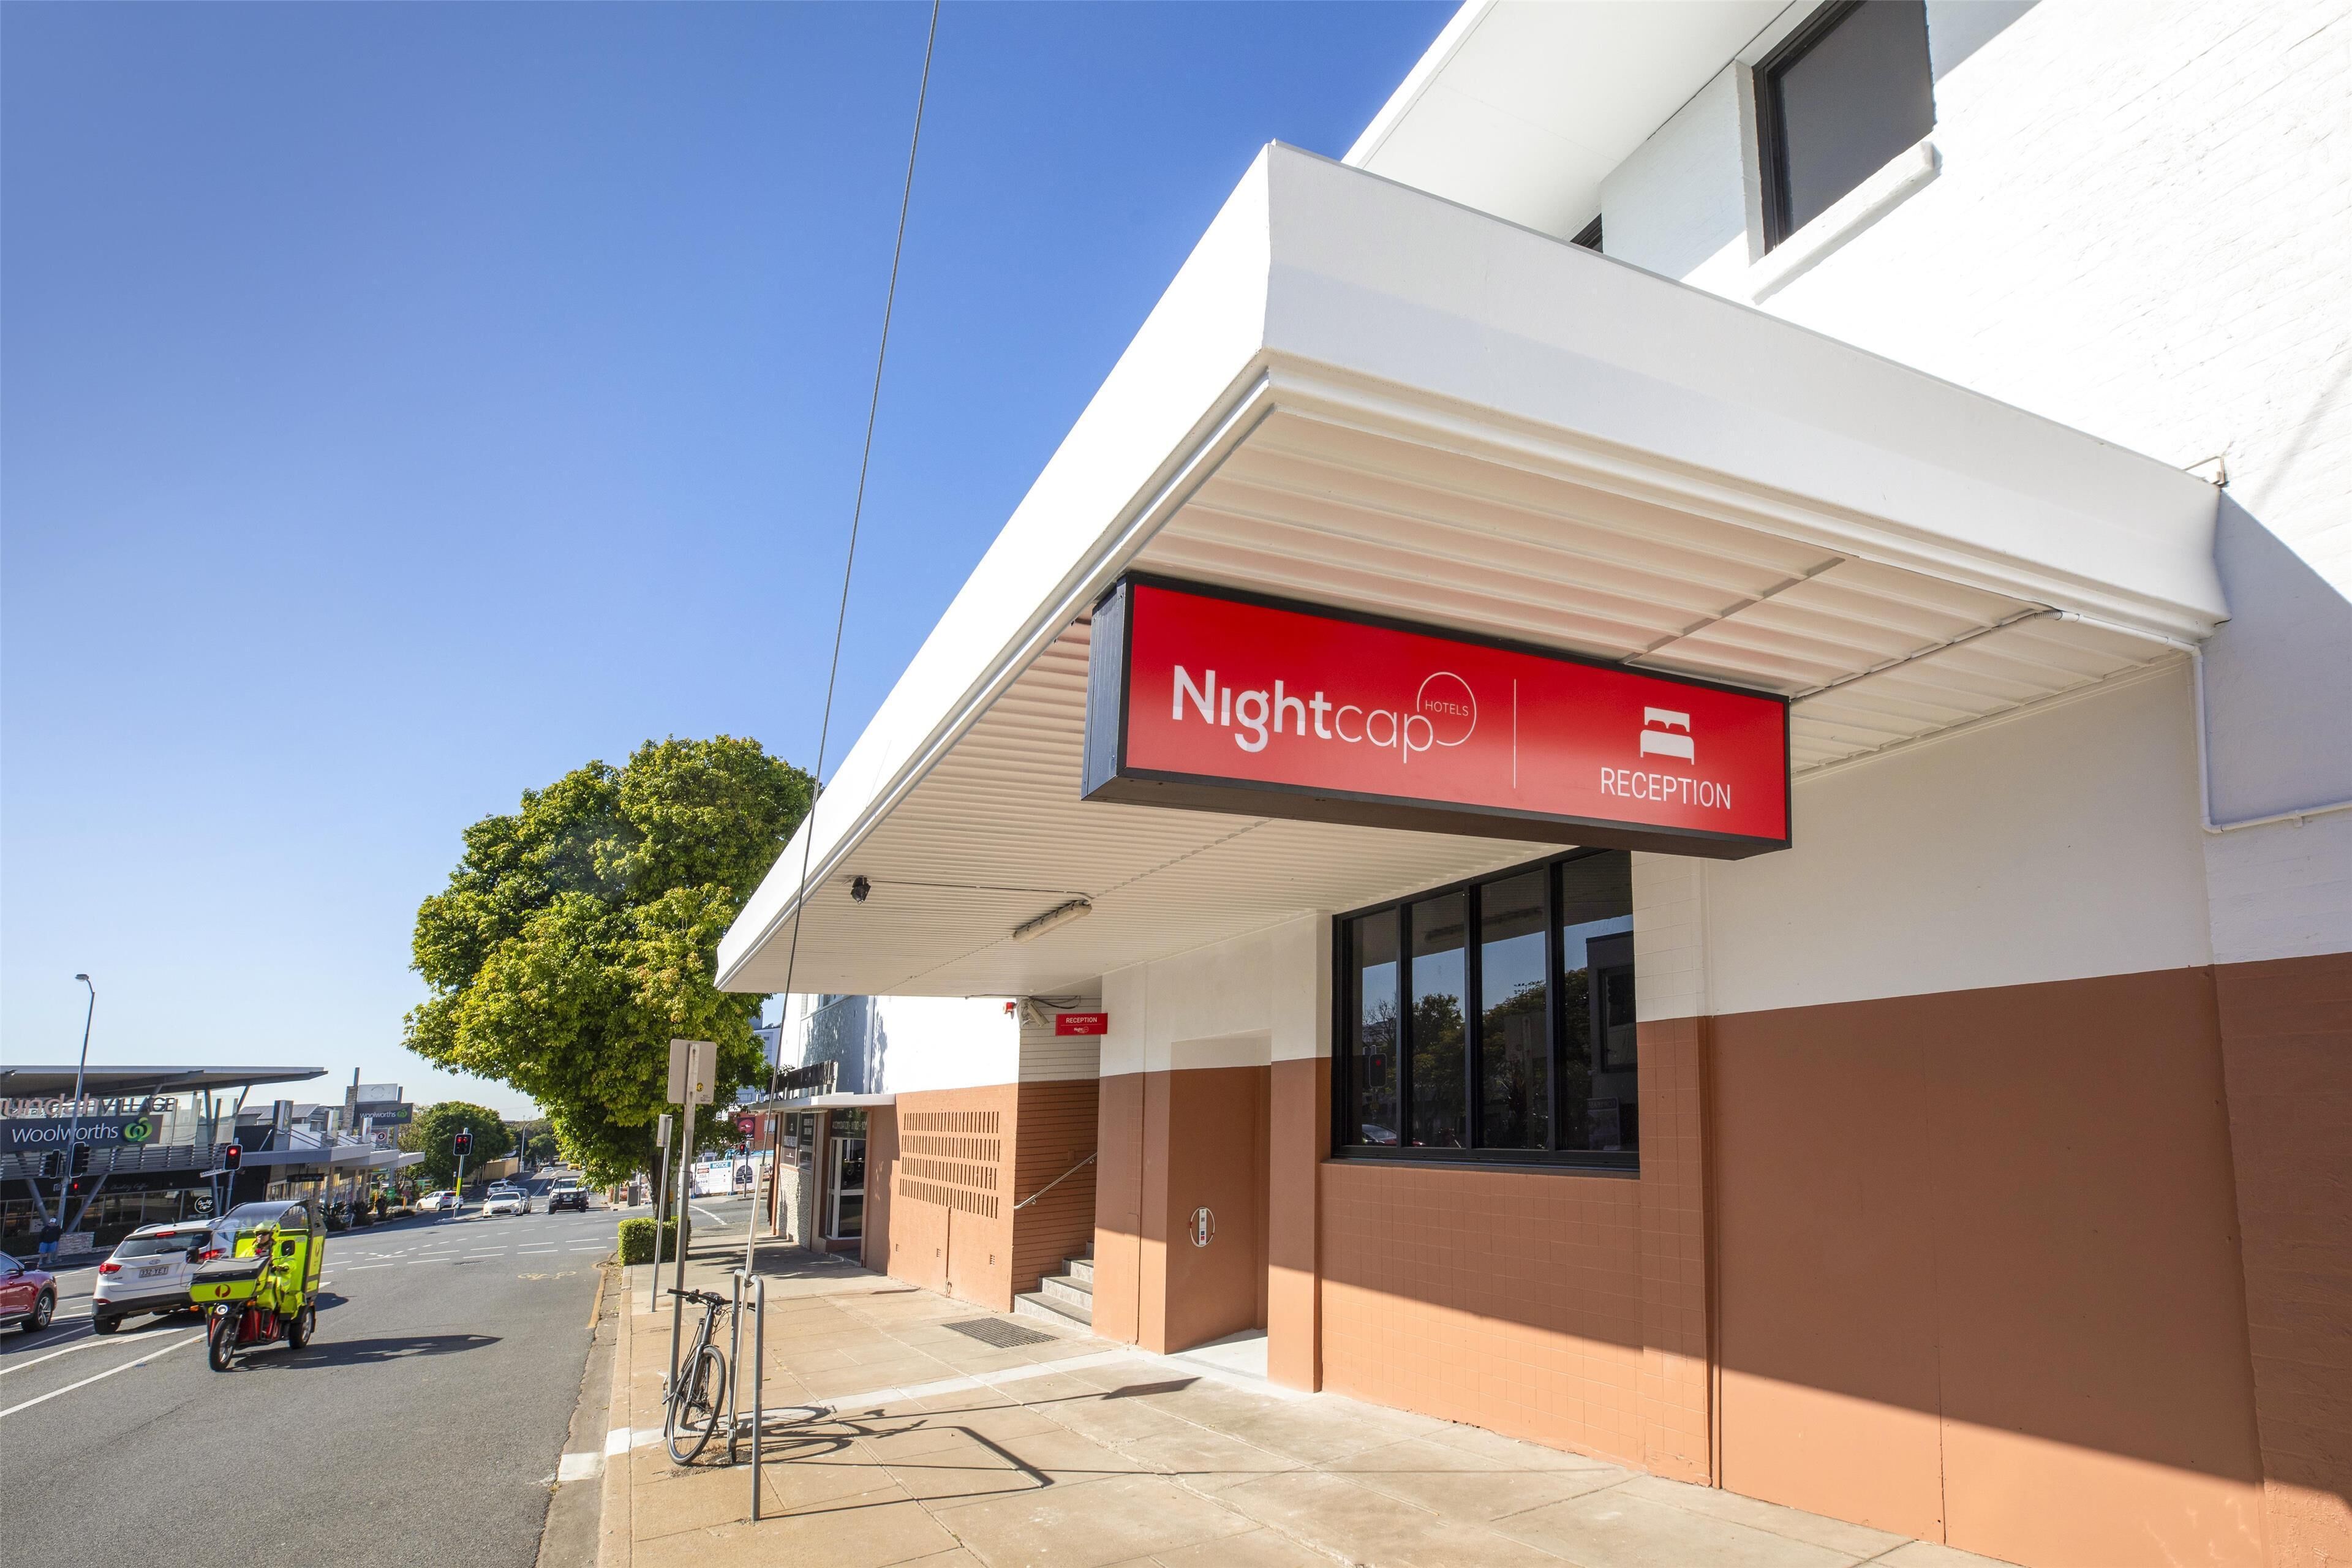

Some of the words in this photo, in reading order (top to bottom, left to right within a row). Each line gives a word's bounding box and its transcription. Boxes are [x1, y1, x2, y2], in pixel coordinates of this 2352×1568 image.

[1172, 665, 1434, 764] Nightcap
[1425, 699, 1469, 717] HOTELS
[1601, 767, 1731, 810] RECEPTION
